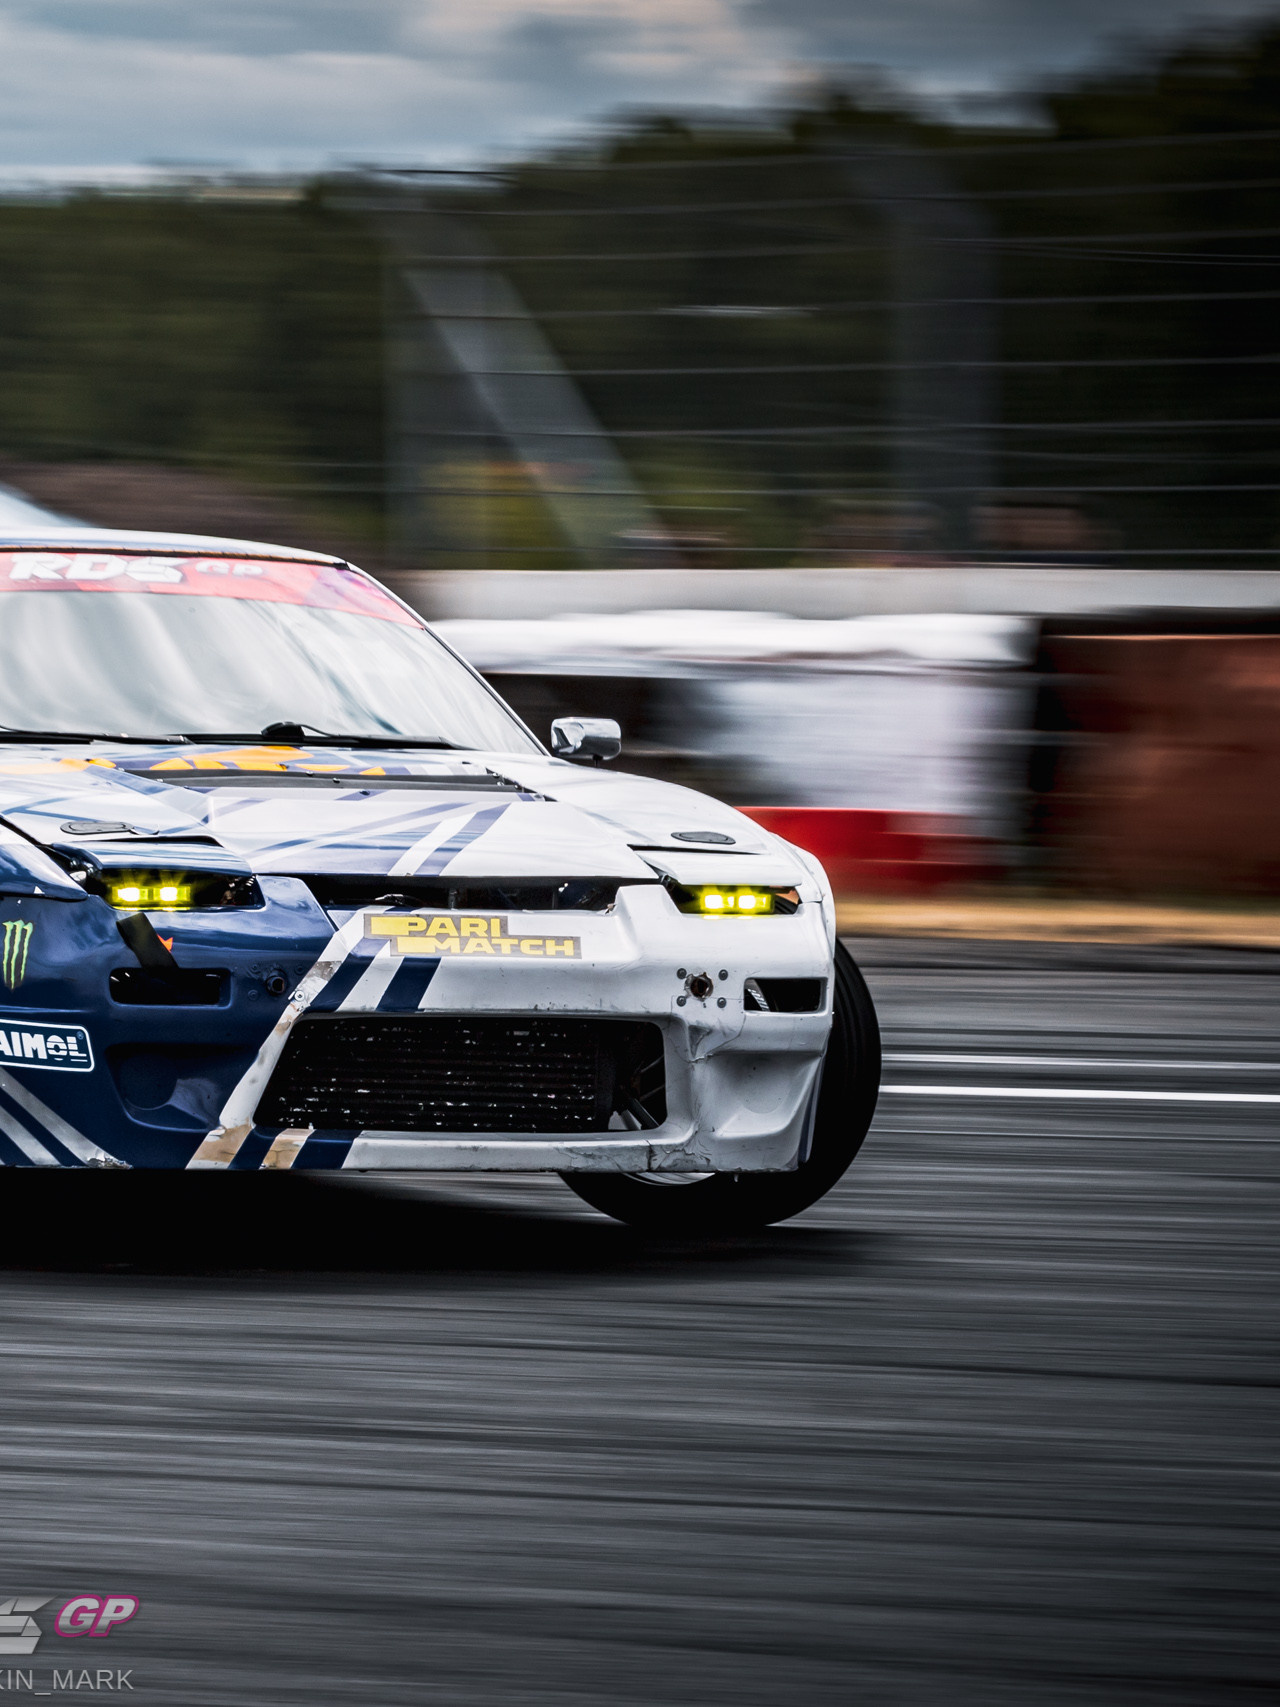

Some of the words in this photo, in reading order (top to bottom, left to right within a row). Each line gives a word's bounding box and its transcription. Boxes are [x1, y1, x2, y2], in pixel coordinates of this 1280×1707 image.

[9, 552, 190, 583] RDS
[196, 561, 263, 576] GP
[371, 916, 501, 937] PARI
[397, 936, 574, 956] MATCH
